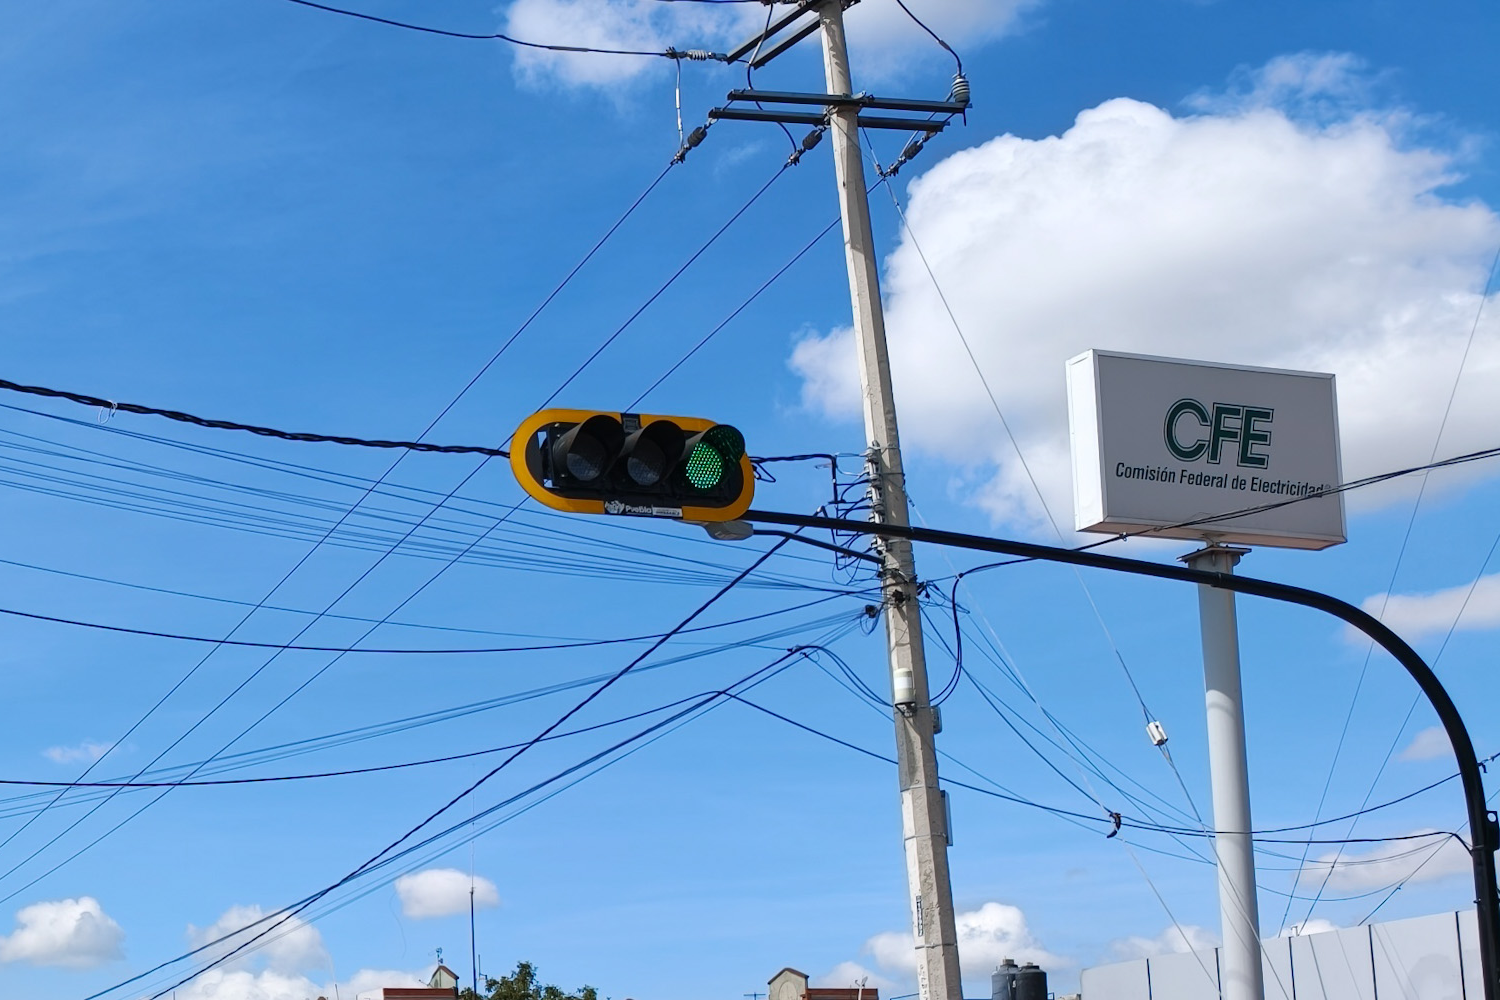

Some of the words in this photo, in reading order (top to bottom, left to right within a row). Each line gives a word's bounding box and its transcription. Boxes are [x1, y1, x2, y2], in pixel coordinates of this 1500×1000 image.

[1164, 398, 1274, 469] CFE
[1115, 461, 1176, 484] Comisión
[1179, 469, 1228, 489] Federal
[1231, 475, 1246, 491] de
[1250, 476, 1324, 498] Electricidad
